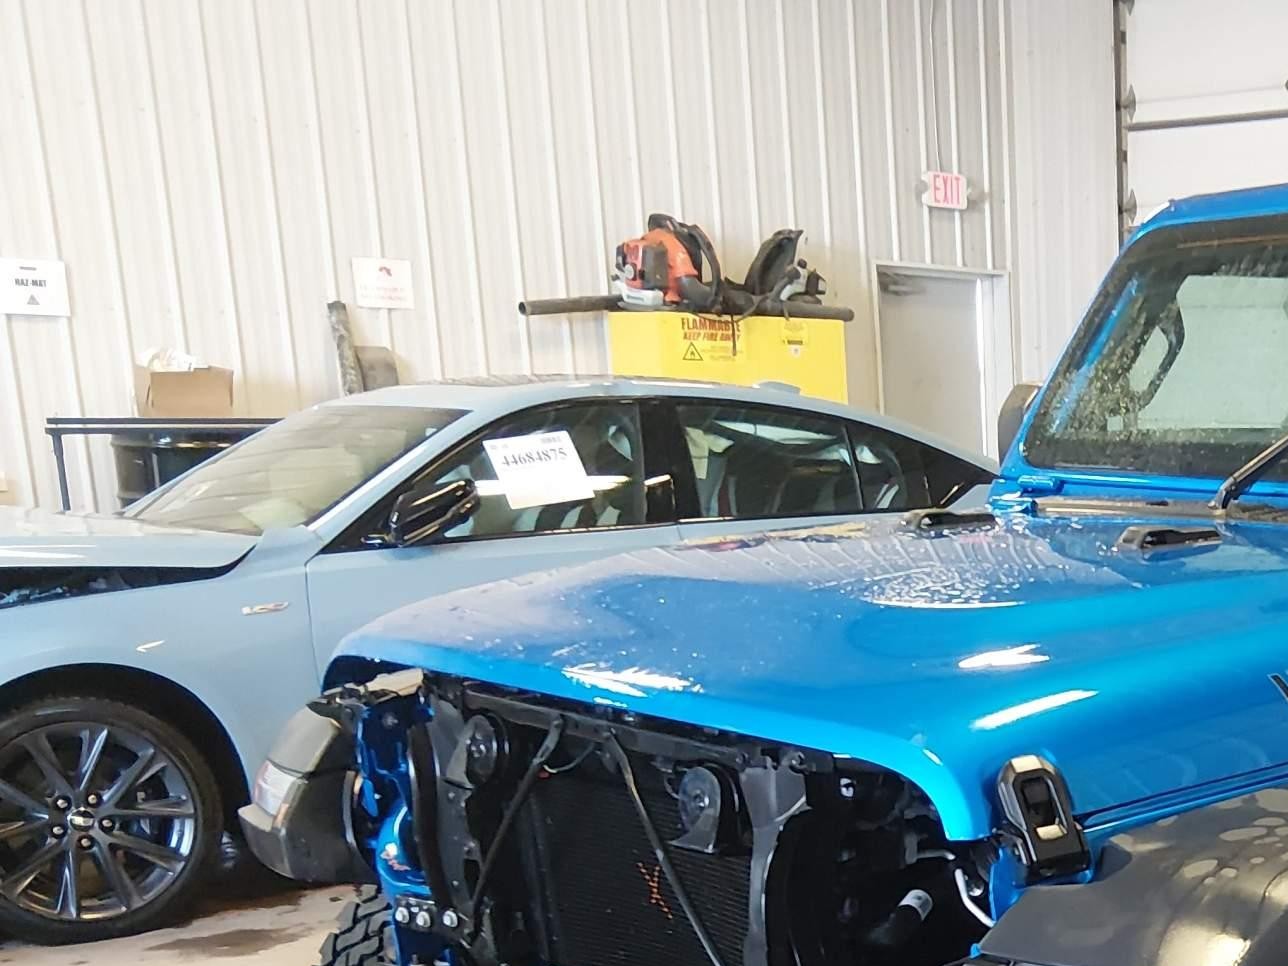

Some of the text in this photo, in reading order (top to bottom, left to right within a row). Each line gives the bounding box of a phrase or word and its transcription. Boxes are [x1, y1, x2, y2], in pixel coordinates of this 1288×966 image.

[933, 174, 961, 205] EXIT
[681, 317, 741, 332] FLAMMABE
[683, 332, 701, 341] KEEP
[502, 447, 568, 467] 44684875
